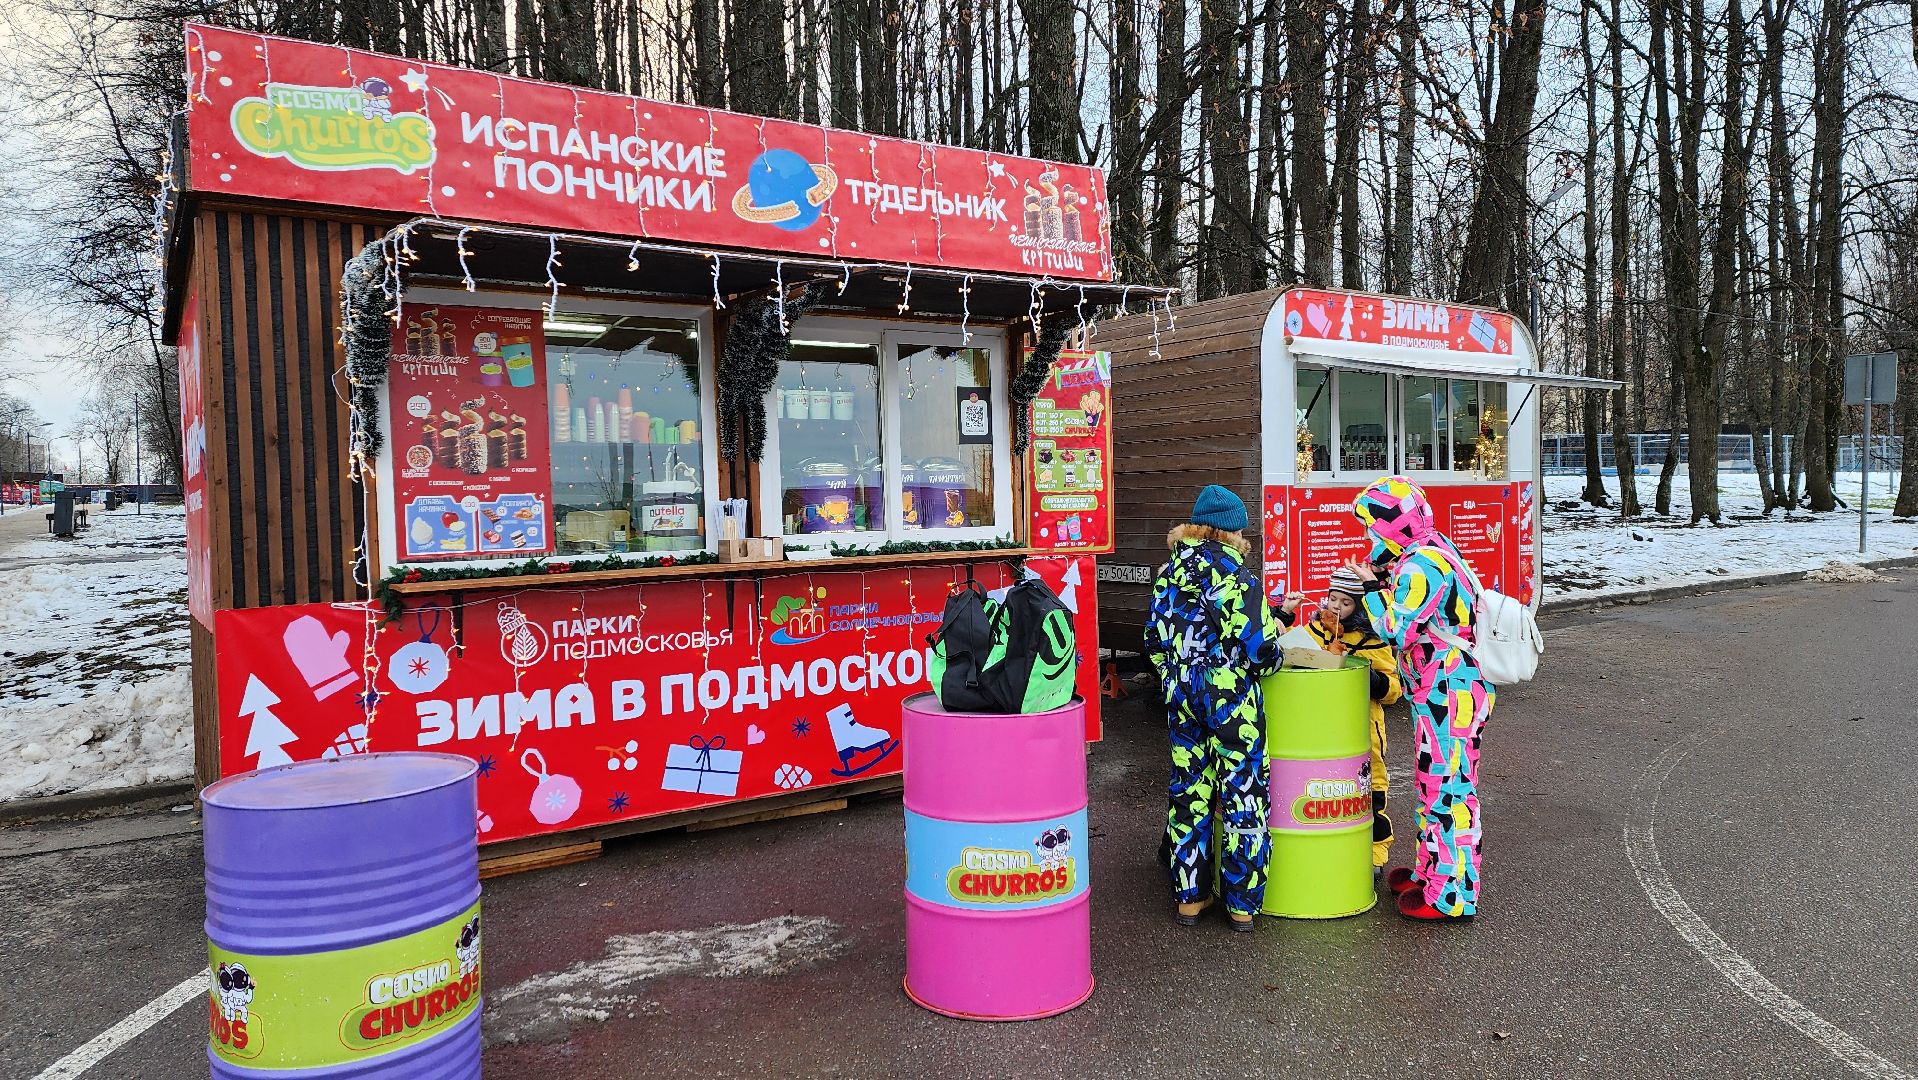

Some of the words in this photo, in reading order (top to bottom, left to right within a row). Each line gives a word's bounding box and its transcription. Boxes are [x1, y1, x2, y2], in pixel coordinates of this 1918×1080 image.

[277, 91, 362, 112] COSMO
[238, 102, 432, 162] Churros
[460, 111, 727, 178] ИСПАНСКИЕ
[494, 155, 712, 213] ПОНЧИКИ
[844, 177, 1008, 222] ТРДЕЛЬНИК
[1022, 248, 1084, 271] КРУТИШИ
[1382, 300, 1450, 334] ЗИМА
[1382, 334, 1389, 345] В
[1390, 335, 1450, 350] ПОДМОСКОВЬЕ
[402, 362, 458, 376] КРУТИШИ
[650, 506, 685, 517] nutella
[1463, 500, 1476, 509] ЕДА
[829, 602, 879, 617] ПАРКИ
[552, 615, 633, 639] ПАРКИ
[553, 629, 733, 661] ПОДМОСКОВЬЯ
[416, 683, 596, 747] ЗИМА
[611, 679, 647, 722] В
[1308, 782, 1355, 798] COSMO
[966, 851, 1028, 871] COSMO
[958, 865, 1068, 897] CHURROS
[369, 962, 448, 1004] COSMO
[359, 964, 479, 1040] CHURROS
